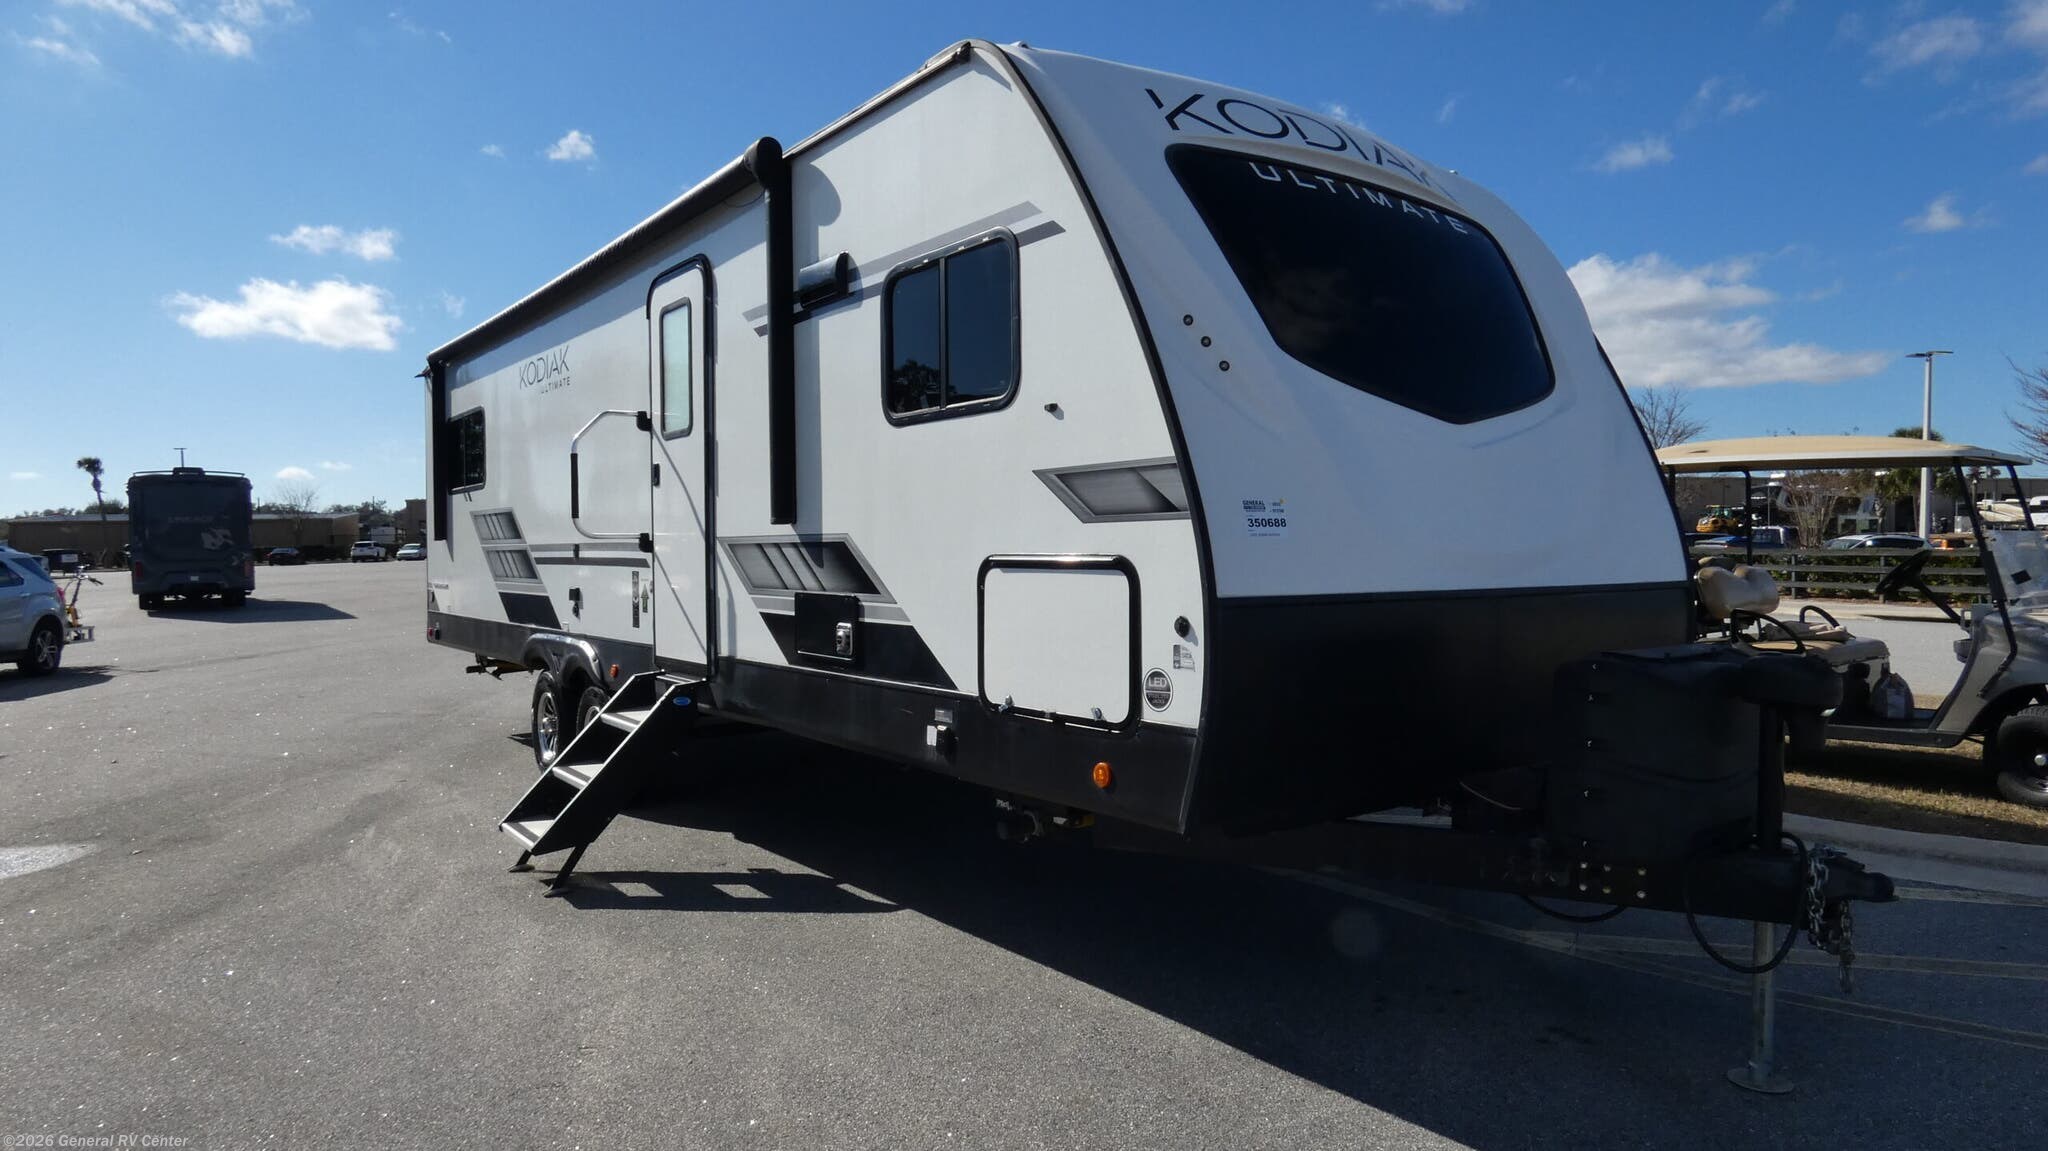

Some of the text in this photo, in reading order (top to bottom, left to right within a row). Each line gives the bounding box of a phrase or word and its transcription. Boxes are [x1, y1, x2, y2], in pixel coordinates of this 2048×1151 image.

[1144, 88, 1457, 201] KODIAK
[1249, 161, 1468, 234] ULTIMATE
[519, 345, 569, 389] KODIAK
[1247, 518, 1287, 528] 350688
[1148, 677, 1167, 688] LED
